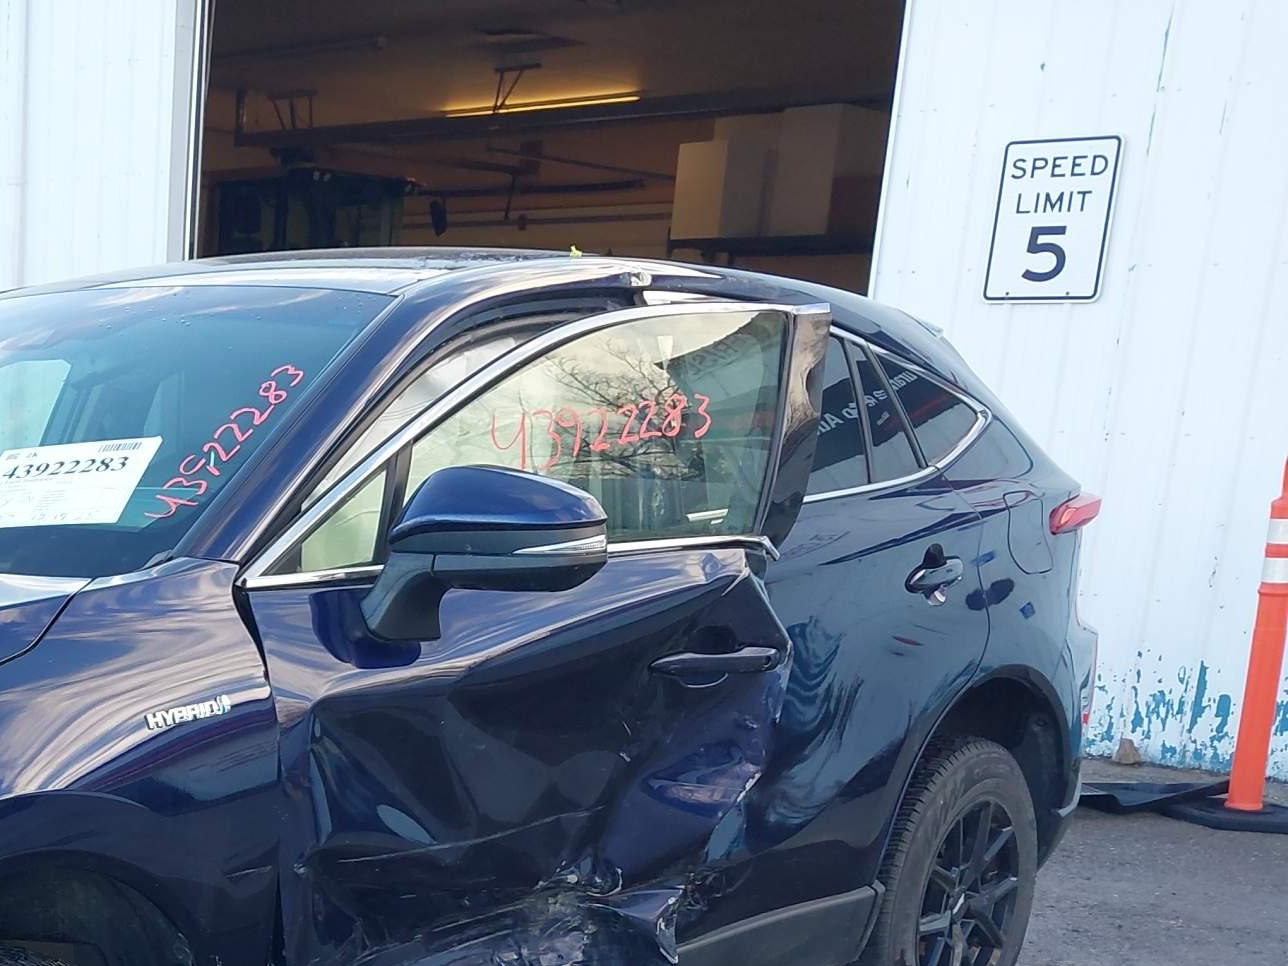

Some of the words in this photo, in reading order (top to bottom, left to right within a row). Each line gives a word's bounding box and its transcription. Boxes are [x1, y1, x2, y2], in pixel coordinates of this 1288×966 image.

[1010, 154, 1109, 180] SPEED
[1015, 190, 1094, 214] LIMIT
[1021, 225, 1067, 282] 5
[143, 363, 305, 519] 43922283
[491, 393, 712, 471] 43922283
[2, 456, 129, 480] 43922283
[145, 696, 231, 731] HYBRID
